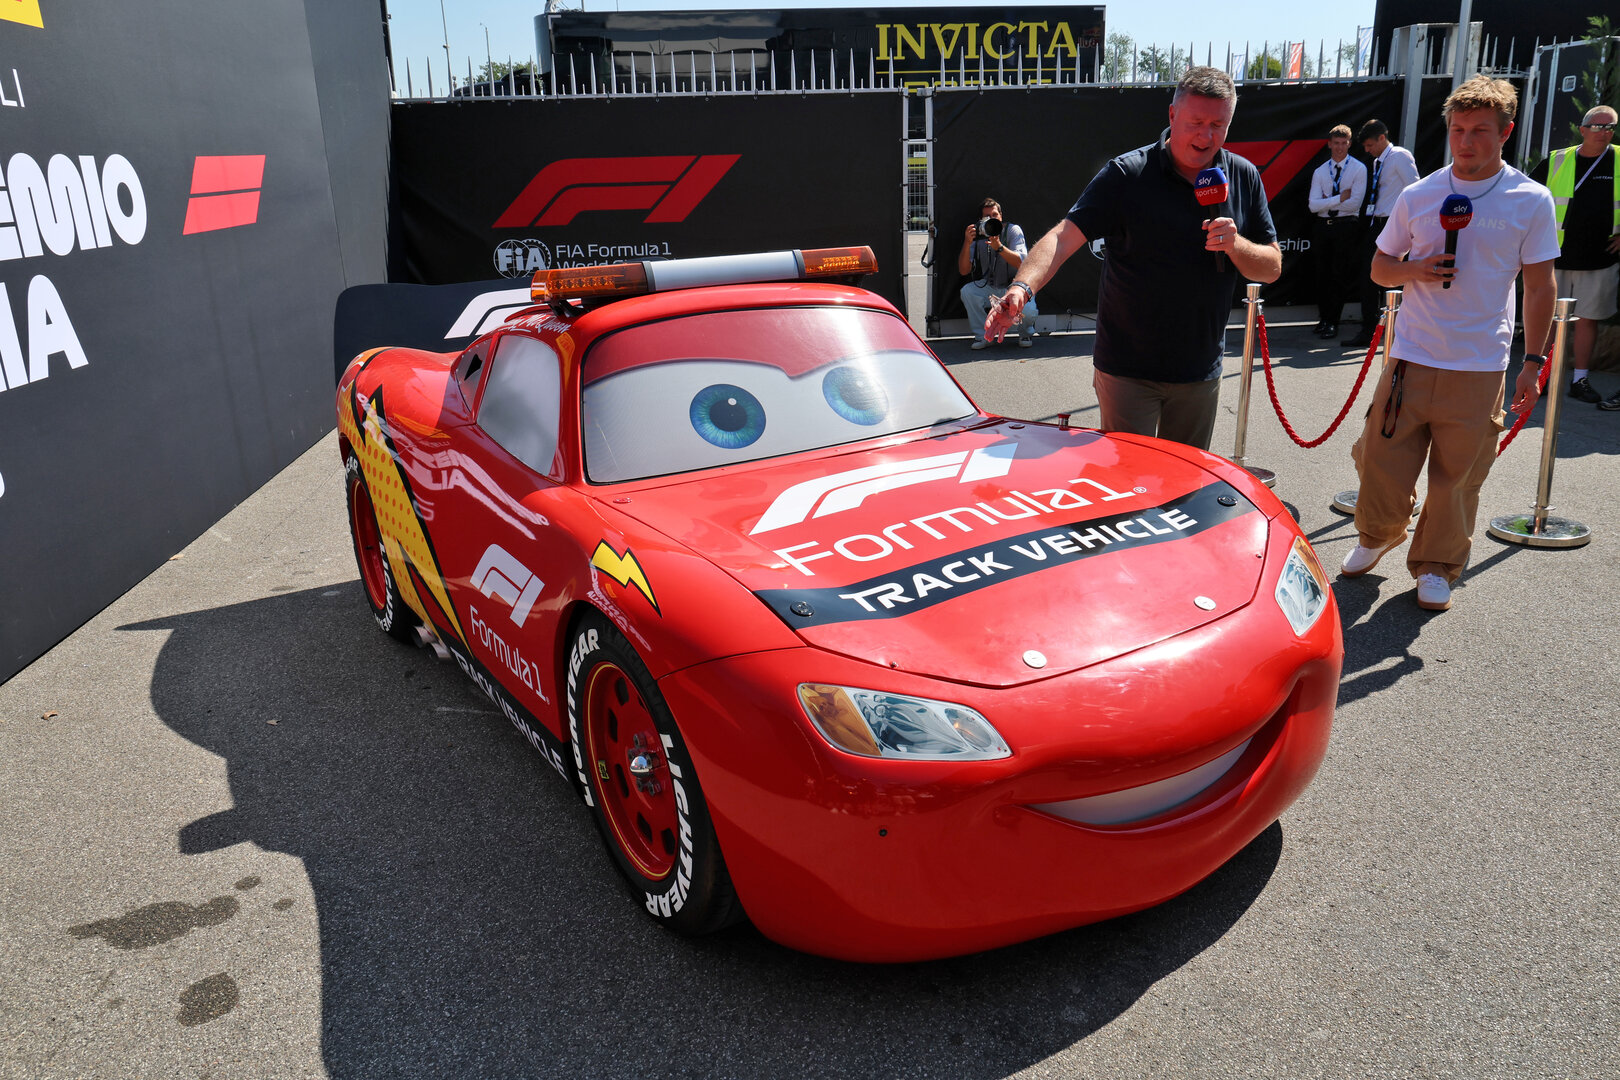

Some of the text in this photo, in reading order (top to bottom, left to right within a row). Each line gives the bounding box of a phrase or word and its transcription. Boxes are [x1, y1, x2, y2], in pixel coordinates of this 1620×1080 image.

[875, 20, 1078, 60] INVICTA
[1198, 176, 1212, 186] sky
[1448, 215, 1471, 224] sports
[1453, 205, 1468, 213] sky
[556, 243, 585, 259] FIA
[588, 242, 659, 258] Formula
[838, 508, 1198, 613] TRACK VEHICLE
[450, 647, 569, 782] TRACK VEHICLE
[567, 628, 600, 807] LIGHTYEAR
[645, 734, 694, 918] LIGHTYEAR
